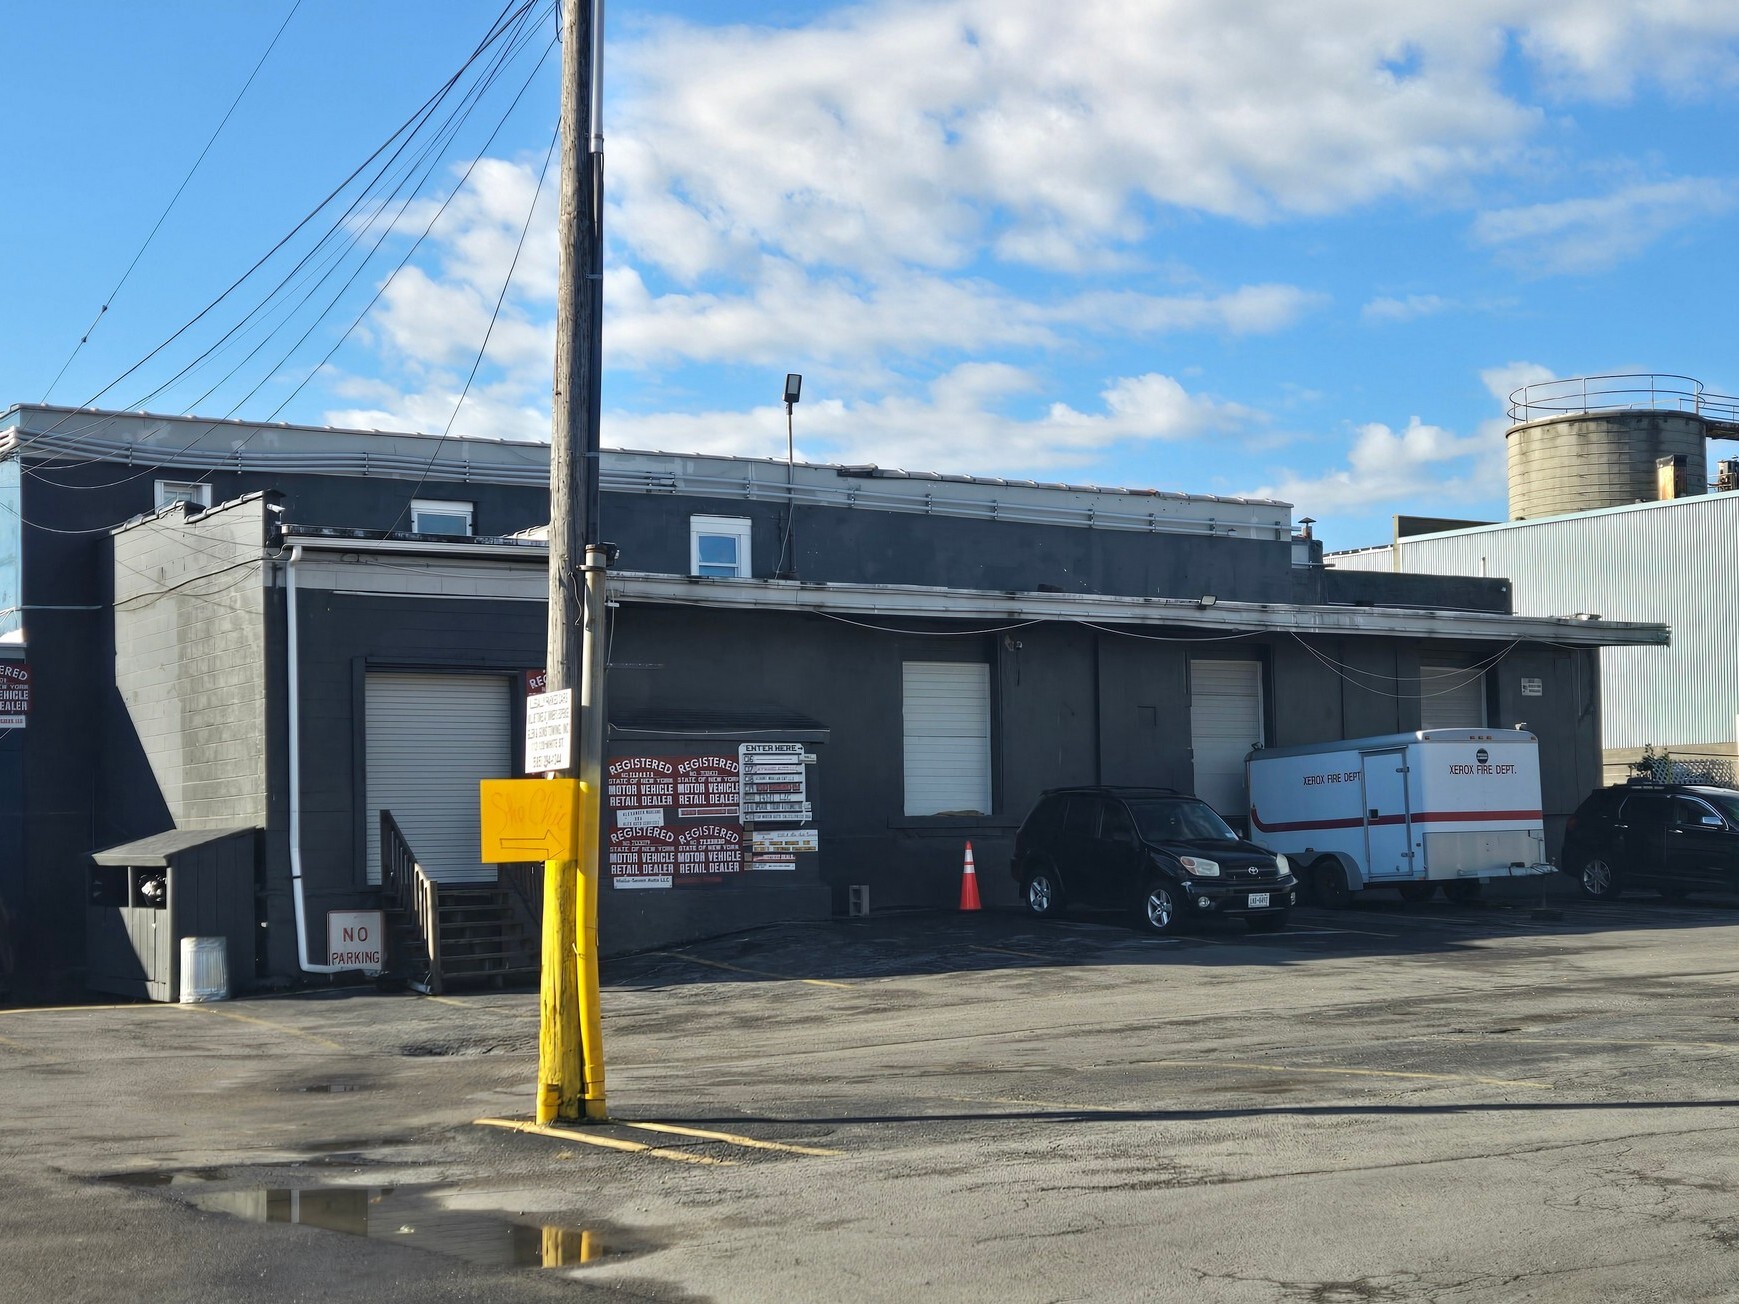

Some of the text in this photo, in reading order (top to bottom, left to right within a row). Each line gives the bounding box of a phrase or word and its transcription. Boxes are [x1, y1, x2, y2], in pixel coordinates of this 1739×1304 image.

[609, 758, 673, 775] REGISTERED
[678, 756, 739, 774] REGISTERED
[1449, 764, 1517, 775] XEROX FIRE DEPT.
[1303, 774, 1325, 785] XEROX
[1327, 773, 1341, 783] FIRE
[608, 784, 674, 795] MOTOR VEHICLE
[678, 784, 705, 794] MOTOR
[708, 782, 739, 792] VEHICLE
[610, 795, 673, 806] RETAIL DEALER
[680, 794, 739, 804] RETAIL DEALER
[610, 826, 674, 844] REGISTERED
[678, 825, 739, 845] REGISTERED
[610, 852, 675, 863] MOTOR VEHICLE
[678, 851, 742, 862] MOTOR VEHICLE
[611, 864, 674, 874] RETAIL DEALER
[680, 862, 740, 874] RETAIL DEALER
[342, 926, 368, 942] NO
[332, 951, 380, 966] PARKING
